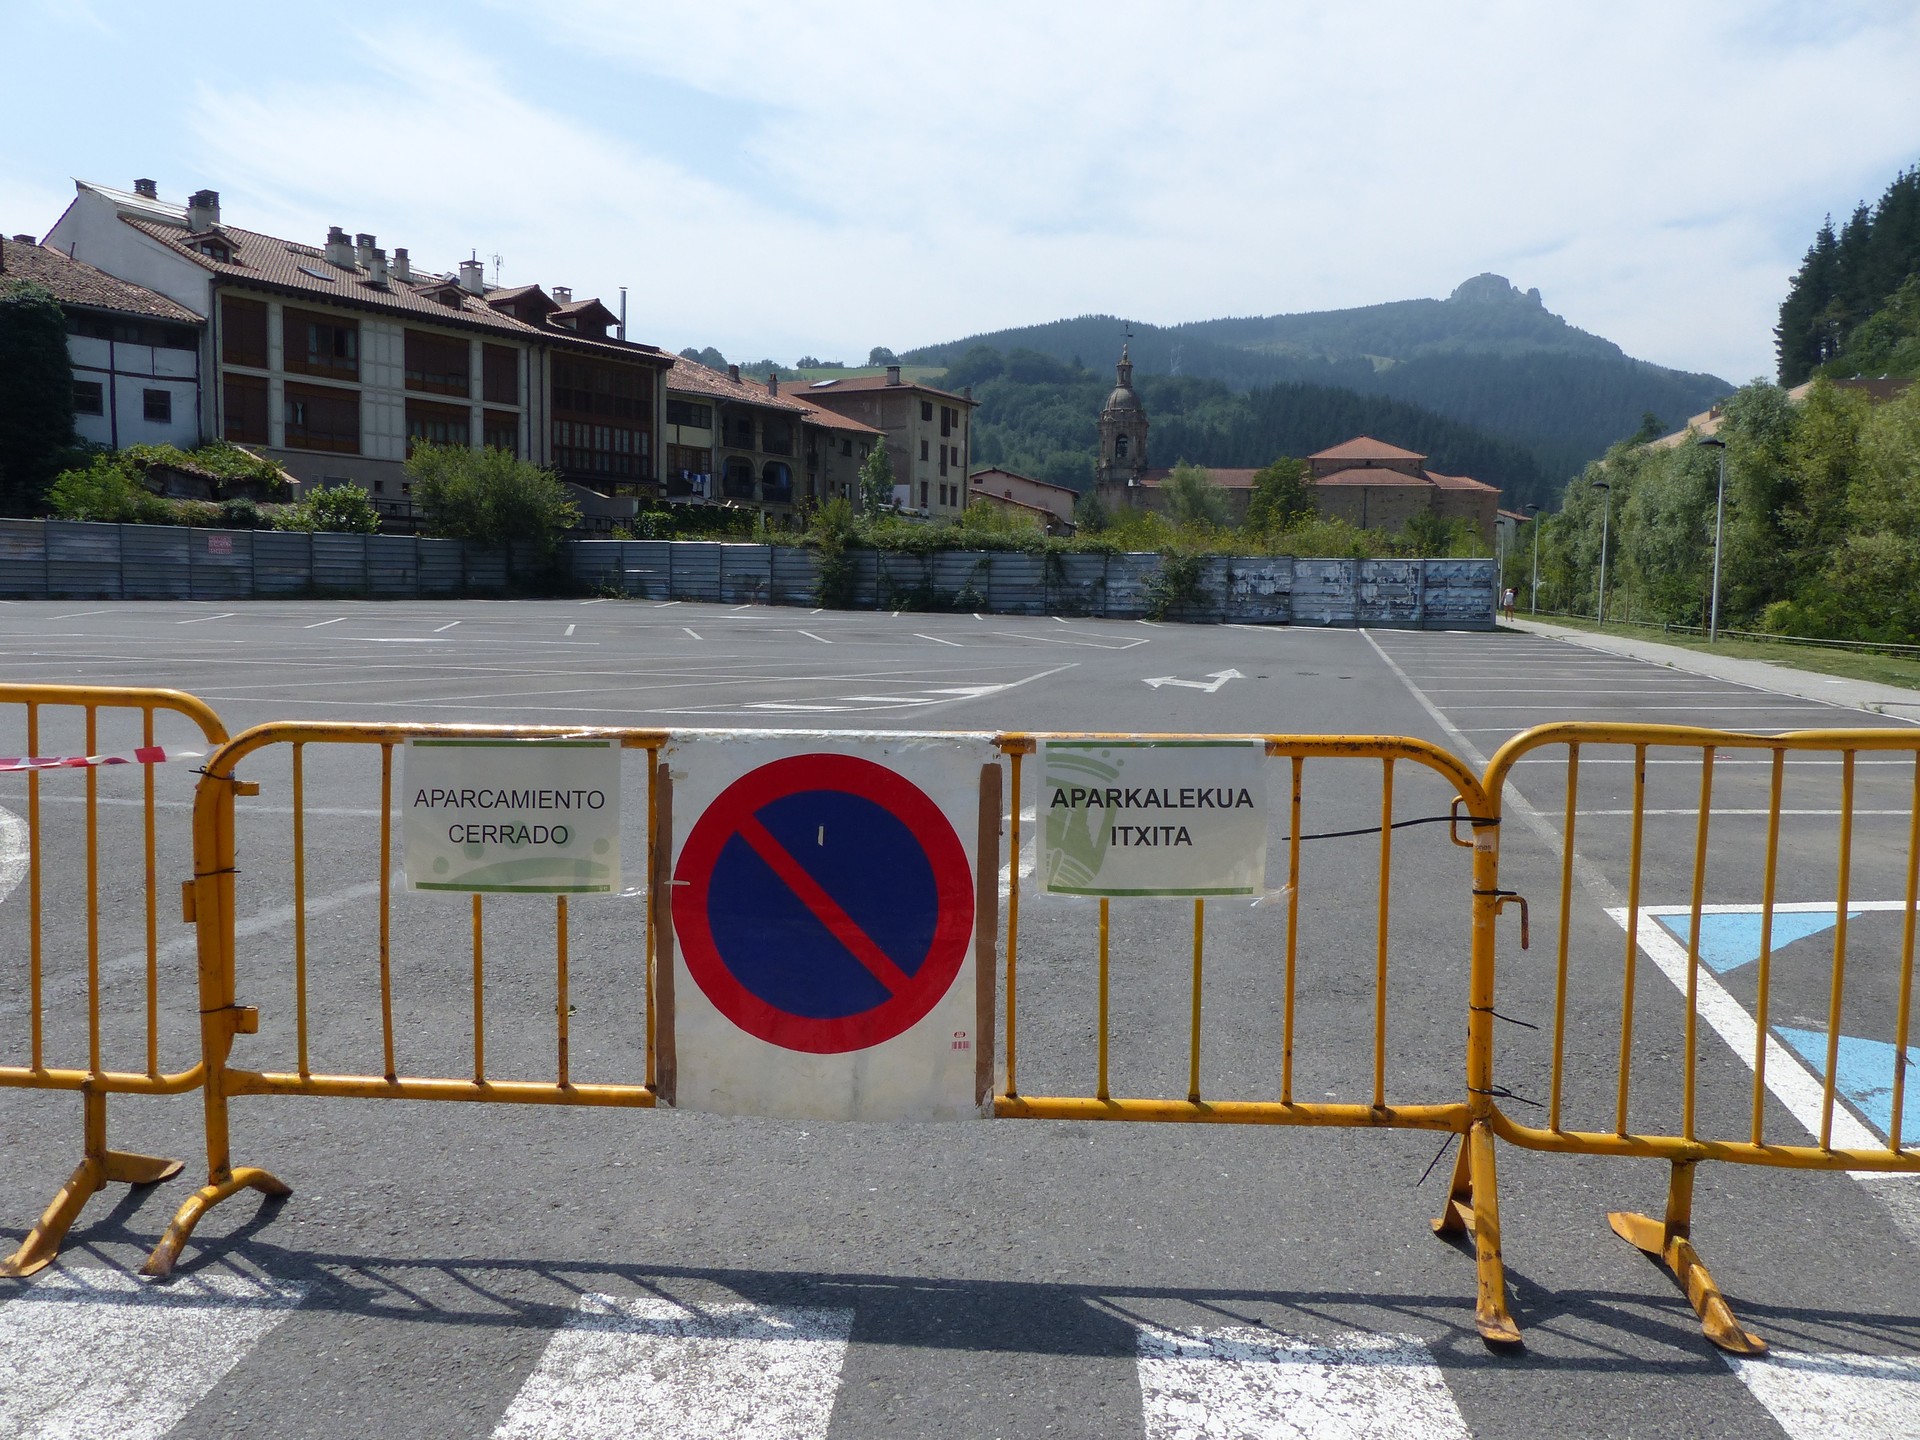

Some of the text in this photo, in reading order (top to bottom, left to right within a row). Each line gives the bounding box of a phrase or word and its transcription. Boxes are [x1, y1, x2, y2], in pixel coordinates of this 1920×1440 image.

[414, 789, 605, 810] APARCAMIENTO
[1050, 788, 1254, 809] APARKALEKUA
[448, 824, 568, 845] CERRADO
[1111, 826, 1193, 847] ITXITA
